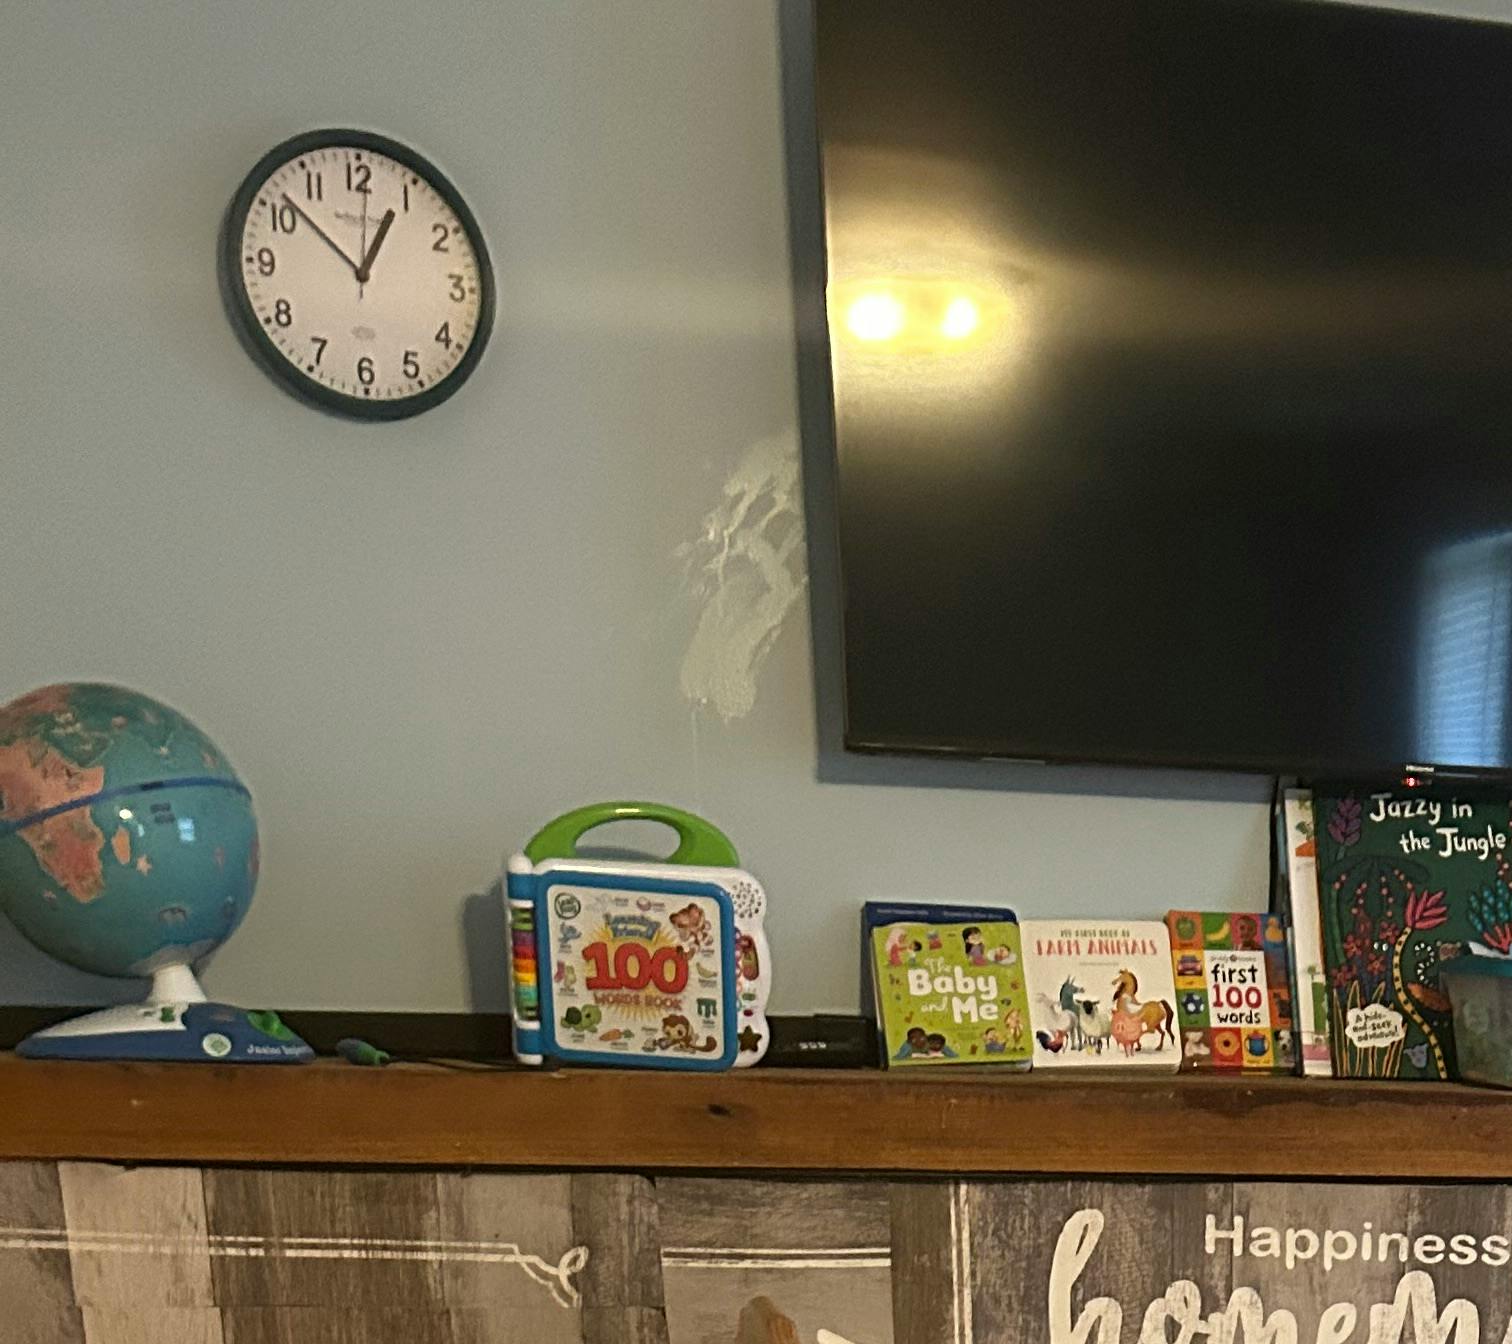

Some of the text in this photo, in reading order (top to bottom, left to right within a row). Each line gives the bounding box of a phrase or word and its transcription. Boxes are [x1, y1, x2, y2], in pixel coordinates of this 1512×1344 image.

[306, 170, 323, 202] 11
[346, 163, 372, 195] 12
[402, 183, 409, 213] 1
[270, 202, 297, 234] 10
[431, 223, 450, 252] 2
[257, 247, 276, 277] 9
[447, 273, 467, 303] 3
[274, 298, 293, 328] 8
[434, 321, 452, 351] 4
[310, 337, 328, 366] 7
[402, 350, 420, 380] 5
[357, 356, 376, 386] 6
[1369, 792, 1474, 825] Jazzy in
[1399, 824, 1508, 861] the Jungle
[1087, 939, 1158, 956] ANIMALS
[580, 940, 690, 995] 100
[907, 965, 998, 1000] Baby
[1210, 962, 1259, 984] first
[951, 995, 1000, 1024] Me
[1211, 984, 1263, 1009] 100
[1216, 1010, 1261, 1025] words
[1204, 1212, 1512, 1272] Happiness
